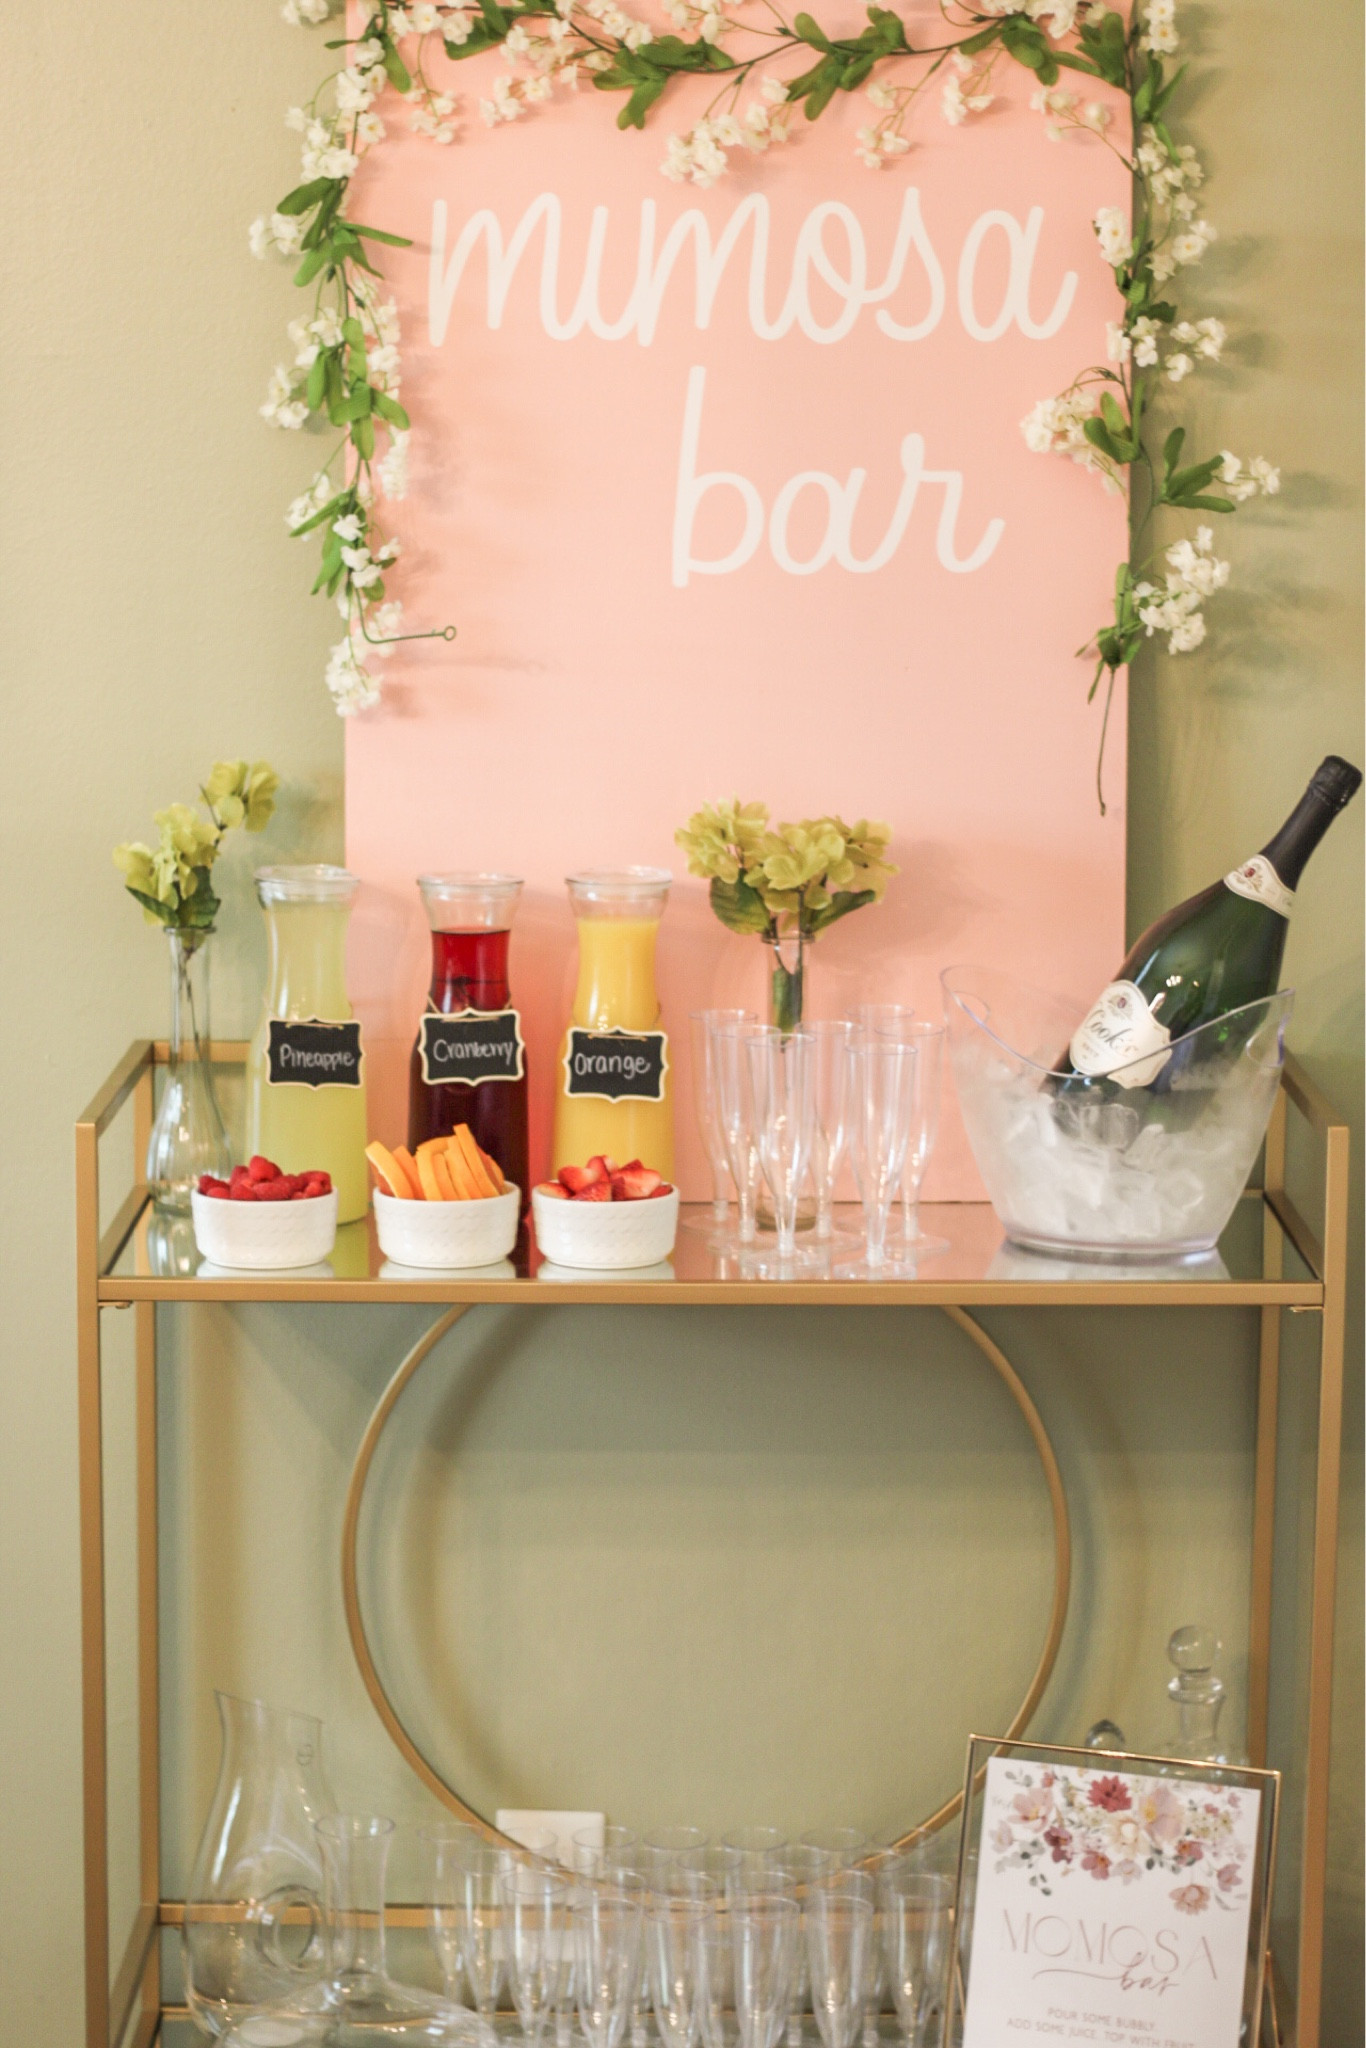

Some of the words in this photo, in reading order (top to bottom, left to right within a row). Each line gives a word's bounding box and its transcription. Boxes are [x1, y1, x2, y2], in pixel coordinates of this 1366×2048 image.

[428, 186, 1078, 347] mimosa
[672, 365, 1006, 588] bar
[280, 1043, 356, 1072] Pineapple
[433, 1039, 514, 1067] Cranberry
[574, 1052, 652, 1080] Orange
[1047, 2006, 1078, 2020] POUR
[1082, 2011, 1112, 2027] SOME
[1006, 2017, 1032, 2031] ADD
[1035, 2021, 1065, 2035] SOME
[1103, 2030, 1126, 2043] TOP
[1130, 2035, 1161, 2047] WITH
